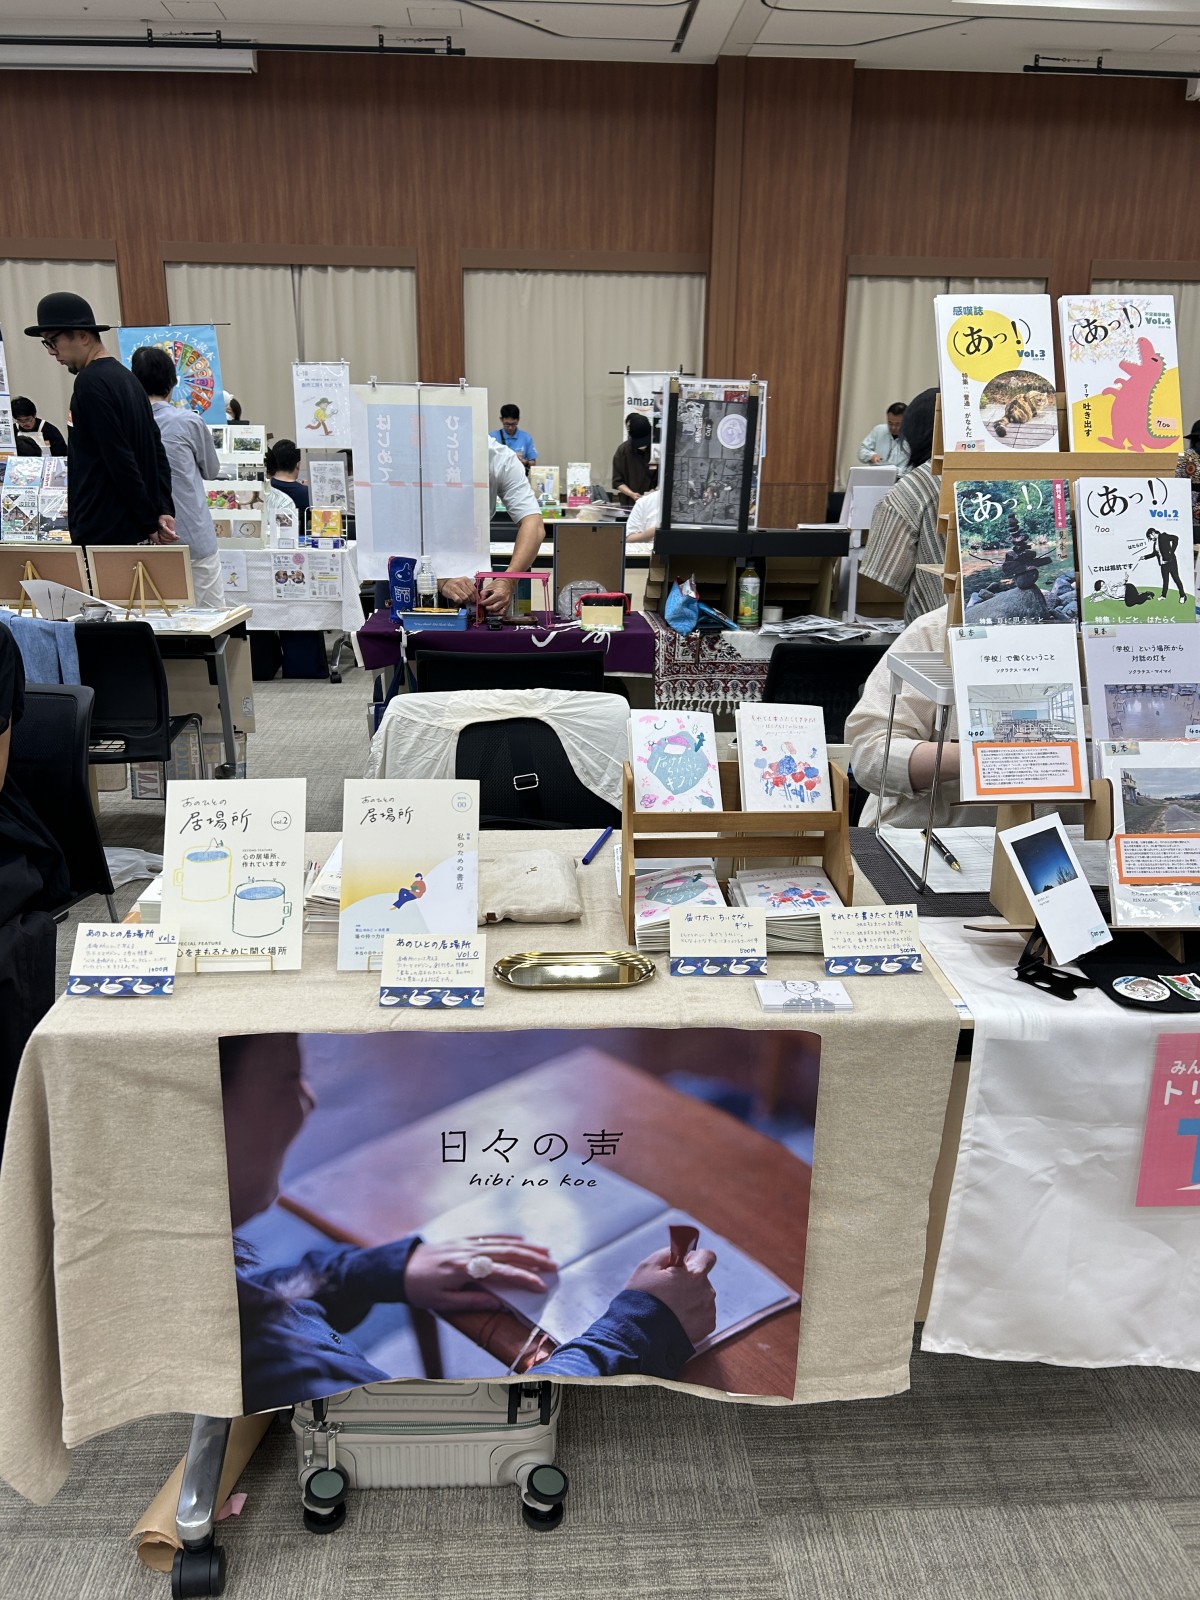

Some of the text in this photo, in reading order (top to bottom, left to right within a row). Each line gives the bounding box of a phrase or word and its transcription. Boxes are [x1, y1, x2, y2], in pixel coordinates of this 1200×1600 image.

[1145, 317, 1172, 325] Vol.4
[1017, 349, 1046, 358] Vol.3
[1082, 403, 1093, 437] 吐き出す
[1149, 509, 1179, 518] Vol.2
[181, 796, 227, 807] あのひとの
[179, 808, 253, 834] 居場所
[360, 806, 414, 825] 居場所
[456, 833, 465, 890] 私のための書店
[86, 929, 155, 939] あのひとの居場所
[396, 938, 471, 950] あのひとの居場所
[441, 1128, 624, 1166] 日々の声
[469, 1173, 598, 1187] hibi no koe
